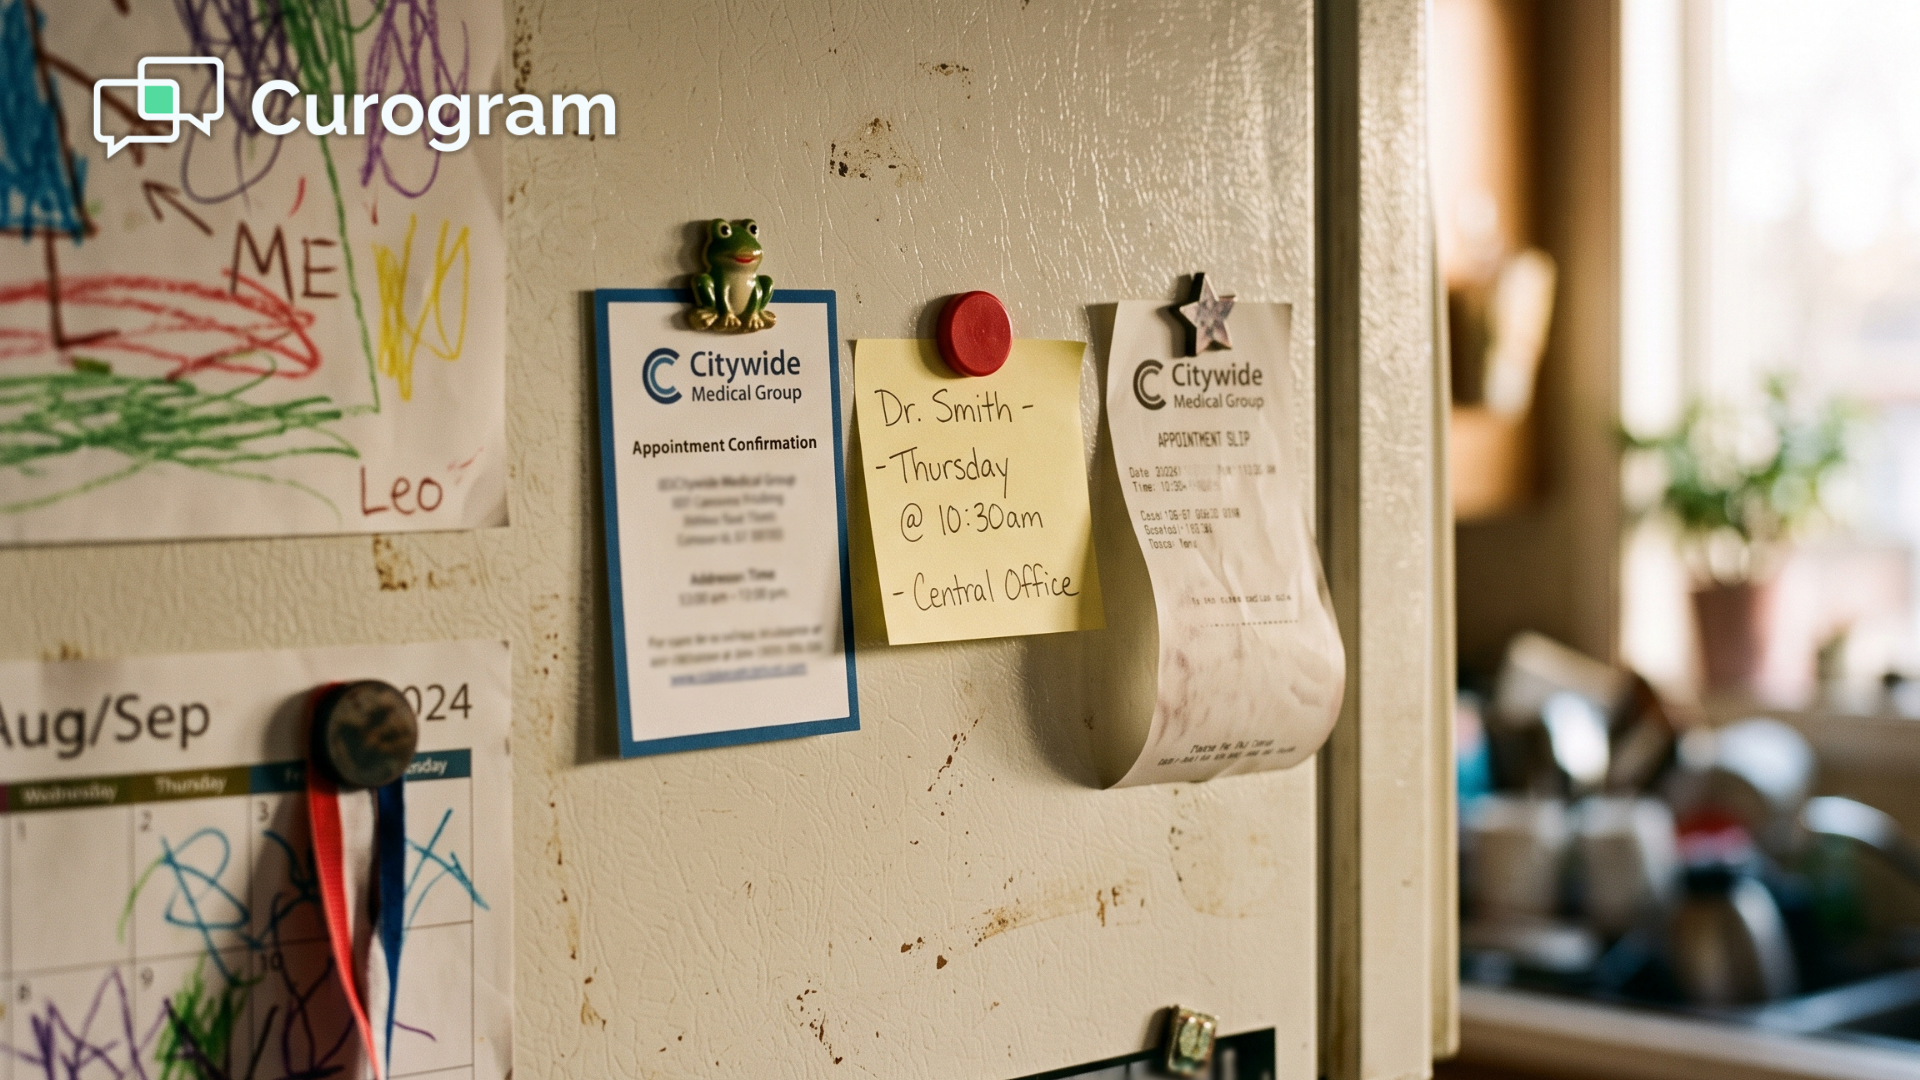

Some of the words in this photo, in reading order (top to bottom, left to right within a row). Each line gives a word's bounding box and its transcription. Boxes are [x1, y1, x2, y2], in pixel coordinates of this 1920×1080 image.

[230, 221, 340, 300] ME
[690, 348, 801, 384] Citywide
[1172, 361, 1263, 393] Citywide
[692, 384, 751, 402] Medical
[755, 384, 803, 404] Group
[874, 388, 921, 427] Dr.
[932, 388, 1013, 423] Smith
[1173, 393, 1223, 410] Medical
[1225, 393, 1265, 411] Group
[632, 438, 725, 459] Appointment
[728, 435, 818, 452] Confirmation
[1158, 430, 1222, 448] APPOINTMENT
[1226, 430, 1251, 447] SLIP
[1129, 466, 1150, 478] Date
[361, 466, 443, 516] Leo
[900, 502, 924, 542] @
[938, 502, 1043, 536] 10:30am
[913, 569, 995, 611] Central
[1004, 563, 1080, 601] Office
[402, 683, 473, 721] 024
[22, 781, 118, 804] Wednesday
[155, 771, 228, 795] Thursday
[140, 811, 152, 831] 2
[258, 802, 270, 822] 3
[141, 968, 153, 988] 9
[260, 952, 281, 970] 10
